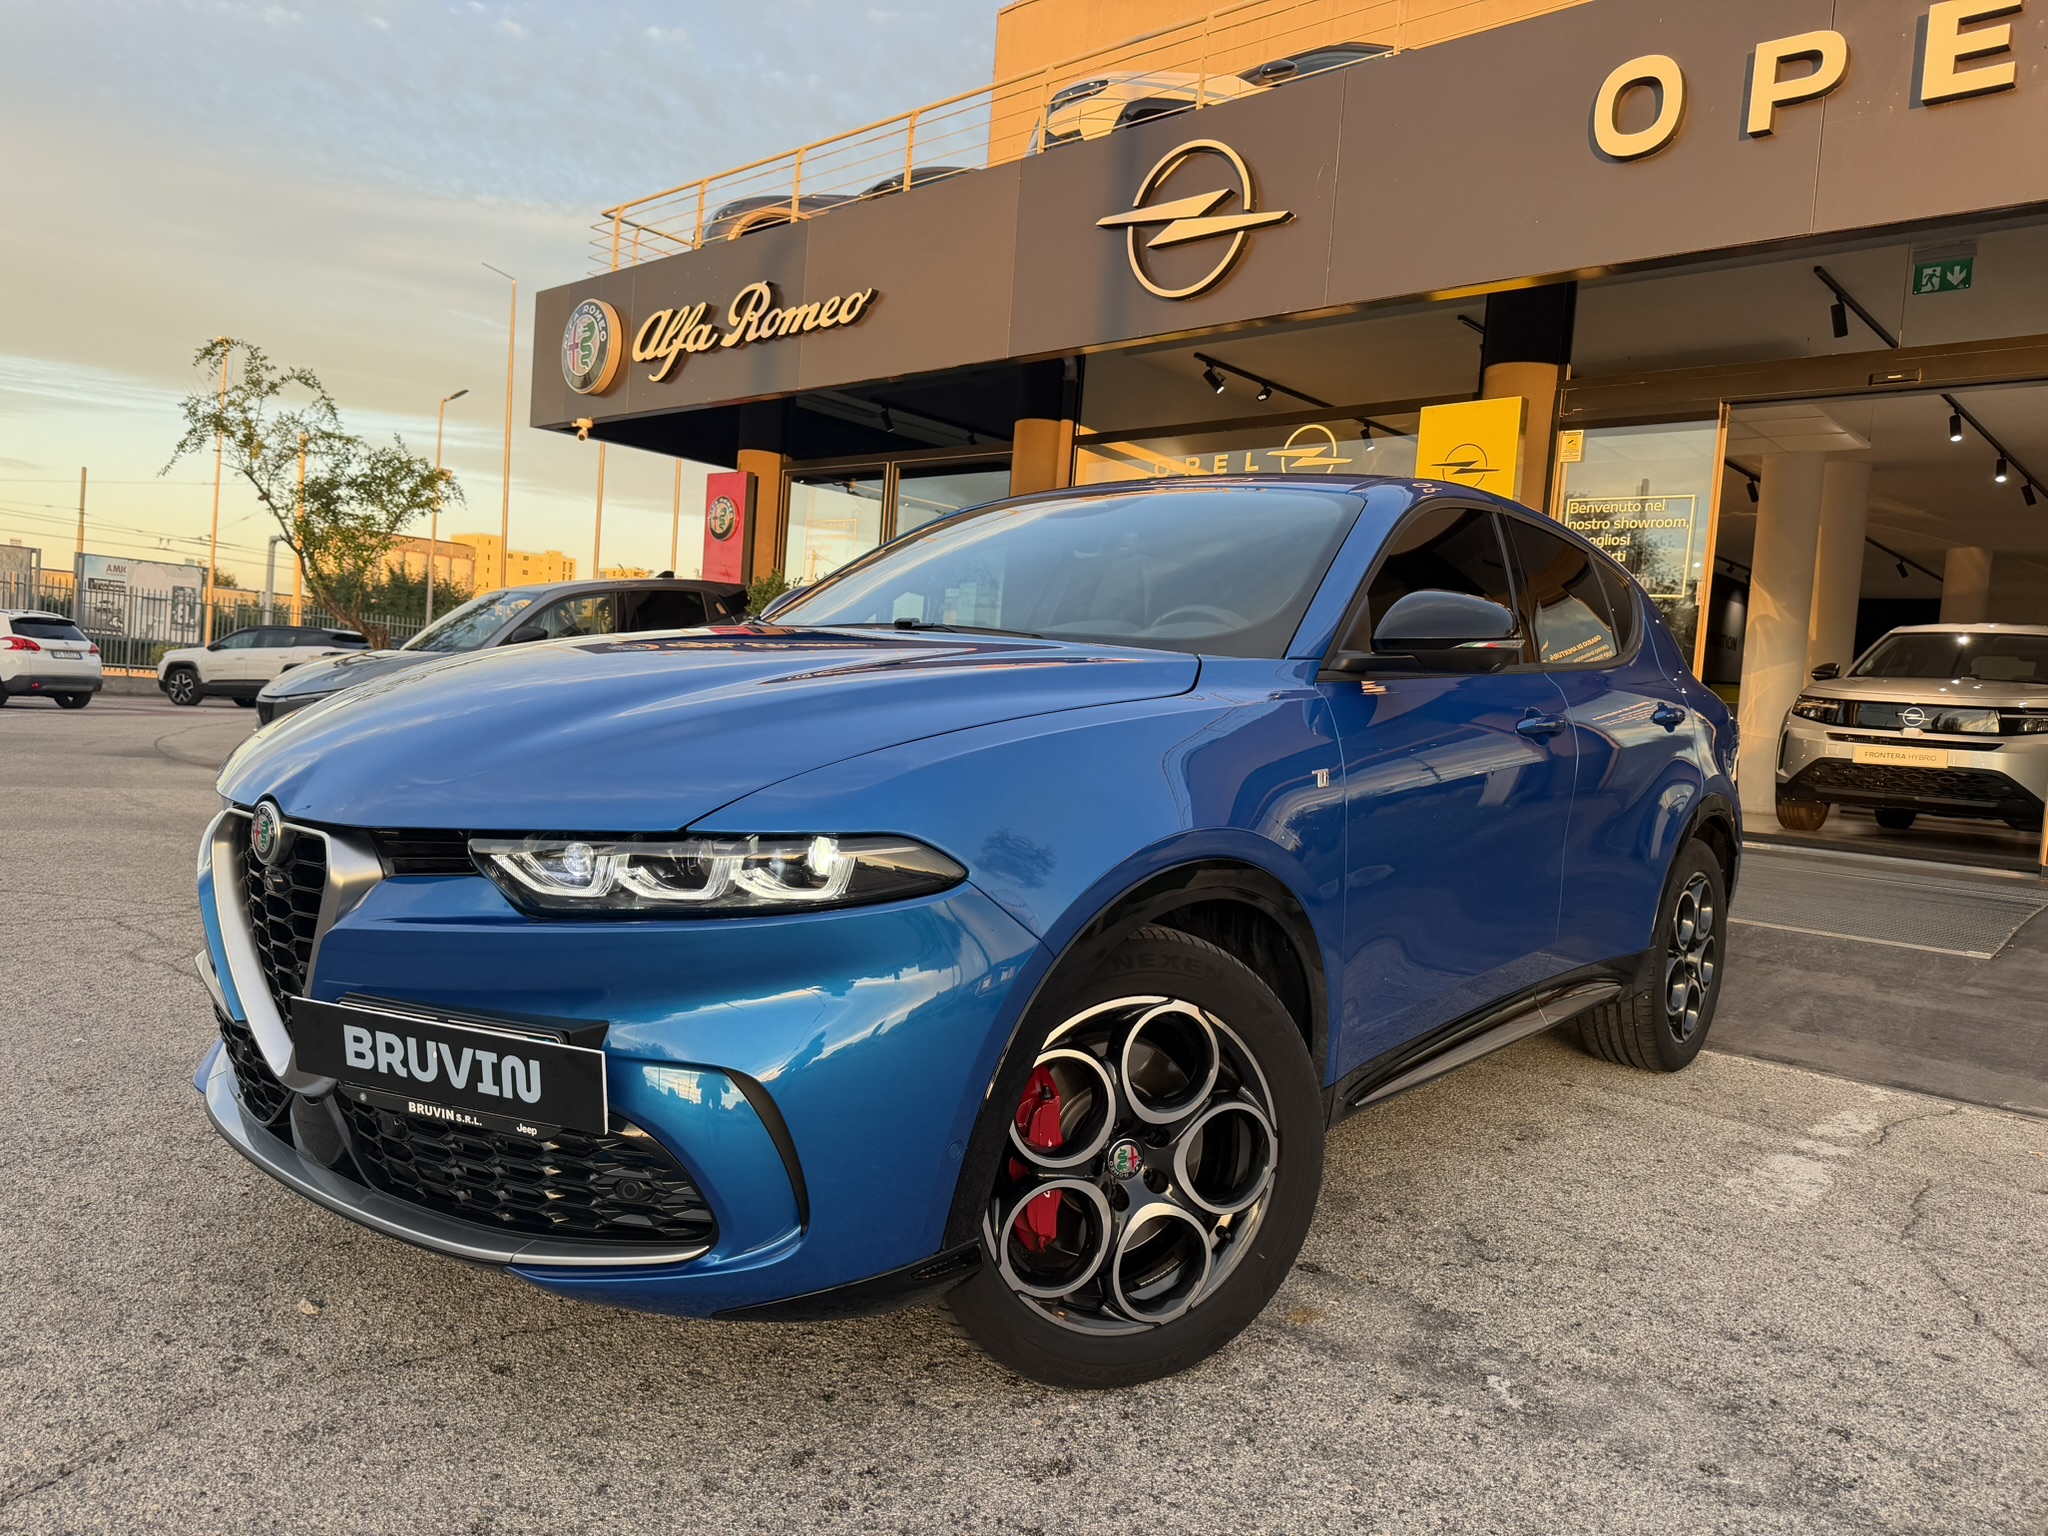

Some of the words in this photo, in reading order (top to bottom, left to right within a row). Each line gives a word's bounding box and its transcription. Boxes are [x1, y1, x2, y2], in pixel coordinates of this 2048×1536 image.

[583, 304, 607, 342] ROMEO
[632, 302, 718, 382] Alfa
[720, 280, 873, 348] Romeo
[1154, 452, 1260, 478] OPEL
[1570, 501, 1641, 514] Benvenuto
[1645, 498, 1666, 512] nel
[1568, 518, 1611, 530] nostro
[1613, 517, 1690, 530] showroom,
[1864, 751, 1906, 760] FRONTERA
[1908, 754, 1937, 762] HYBRID
[1111, 953, 1224, 981] NEXEN
[343, 1024, 542, 1104] BRUVIN
[408, 1102, 455, 1122] BRUVIN
[456, 1114, 483, 1127] S.R.L.
[516, 1123, 538, 1137] Jeep
